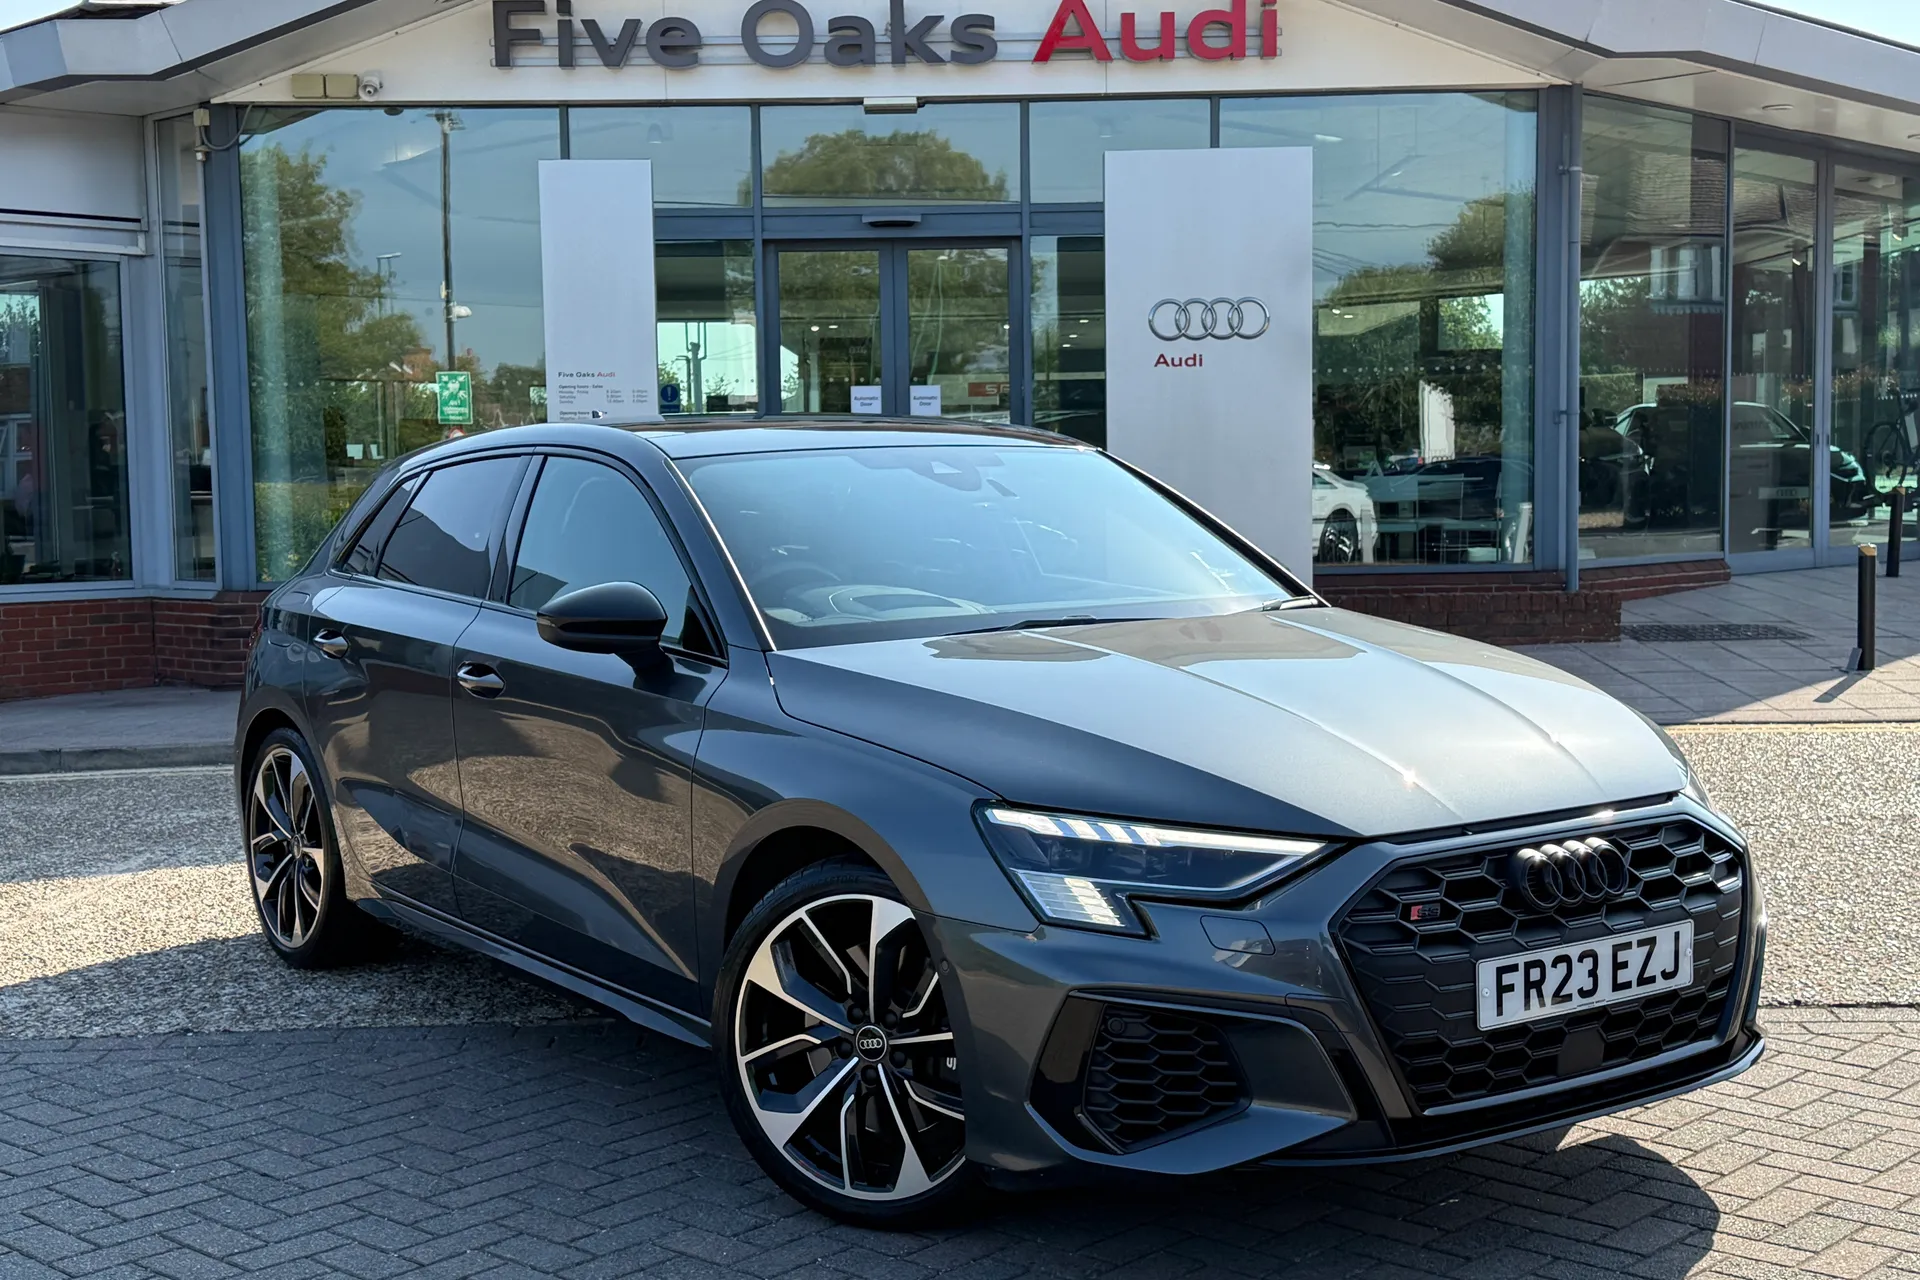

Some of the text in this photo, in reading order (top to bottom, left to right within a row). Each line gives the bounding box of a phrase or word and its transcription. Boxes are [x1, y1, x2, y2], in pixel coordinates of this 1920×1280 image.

[493, 0, 1278, 68] Five Oaks Audi
[1154, 353, 1203, 367] Audi
[1495, 930, 1680, 1017] FR23 EZJ
